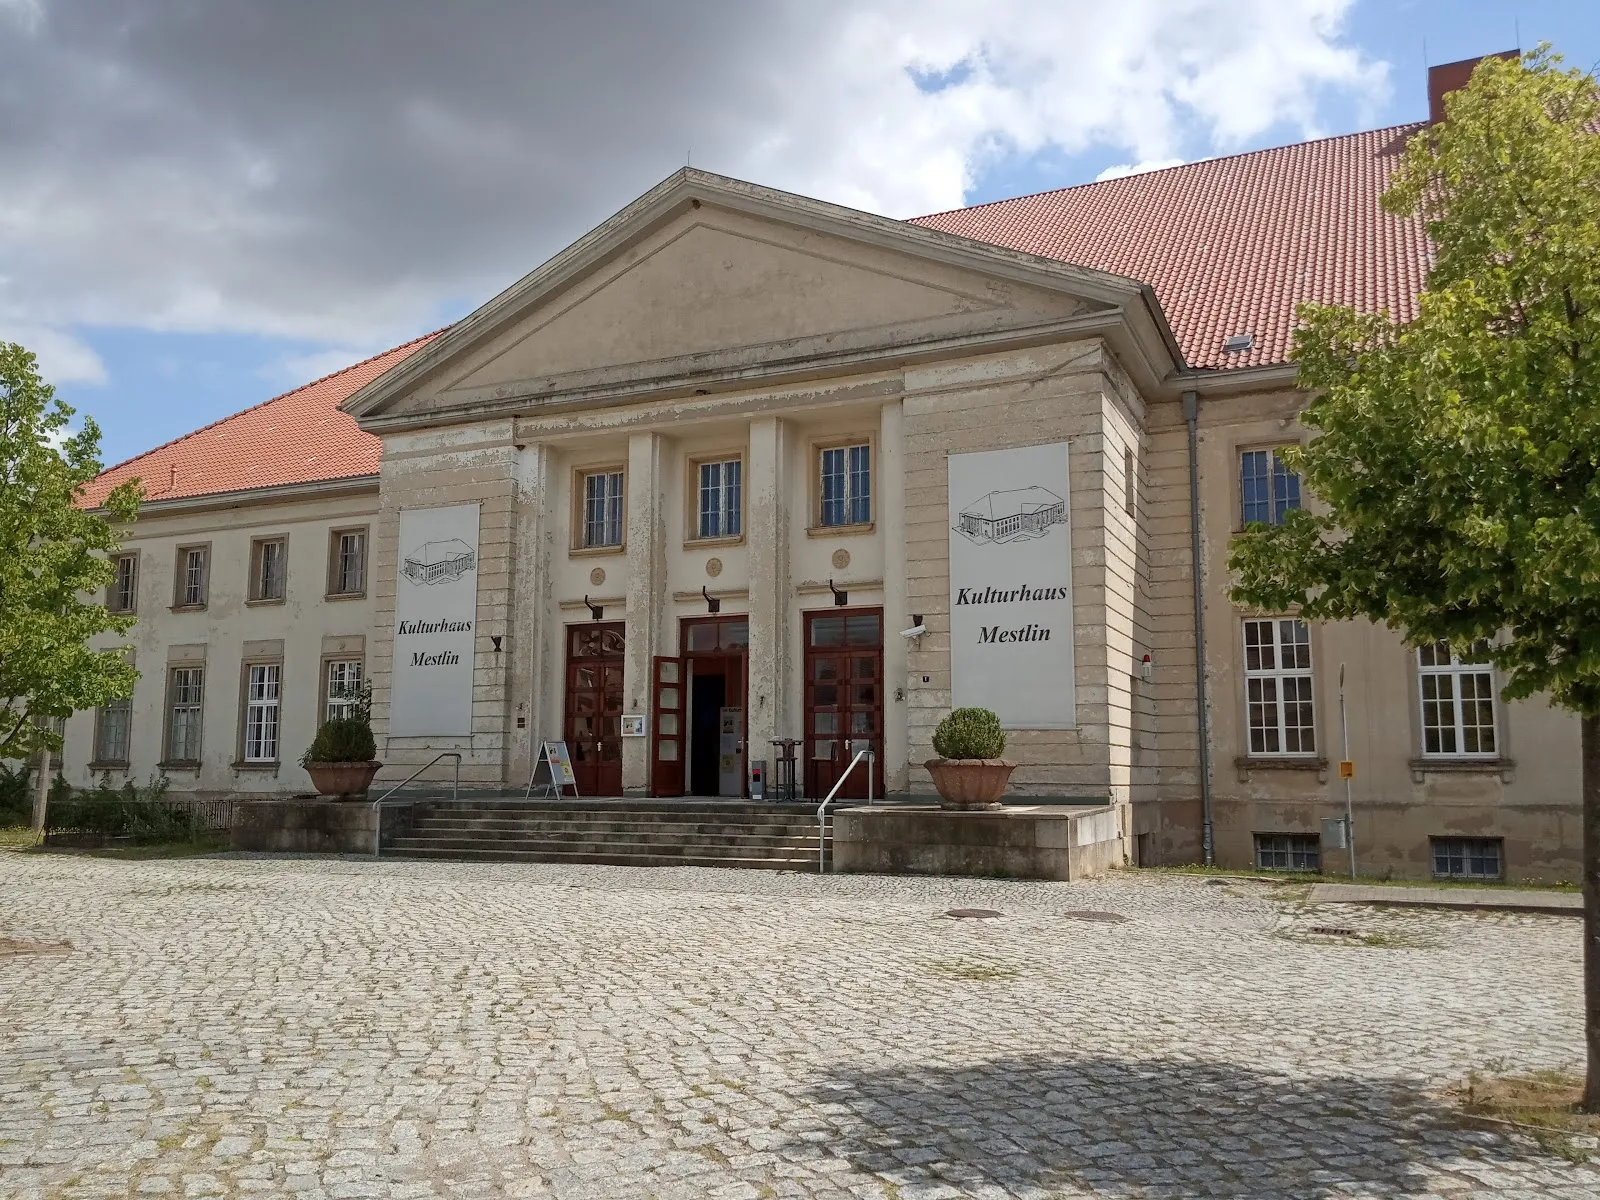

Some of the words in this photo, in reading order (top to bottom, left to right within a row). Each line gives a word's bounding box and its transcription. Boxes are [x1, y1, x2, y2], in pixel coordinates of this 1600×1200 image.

[954, 583, 1067, 606] Kulturhaus
[397, 618, 472, 635] Kulturhaus
[977, 623, 1051, 644] Mestlin
[409, 650, 460, 667] Mestlin
